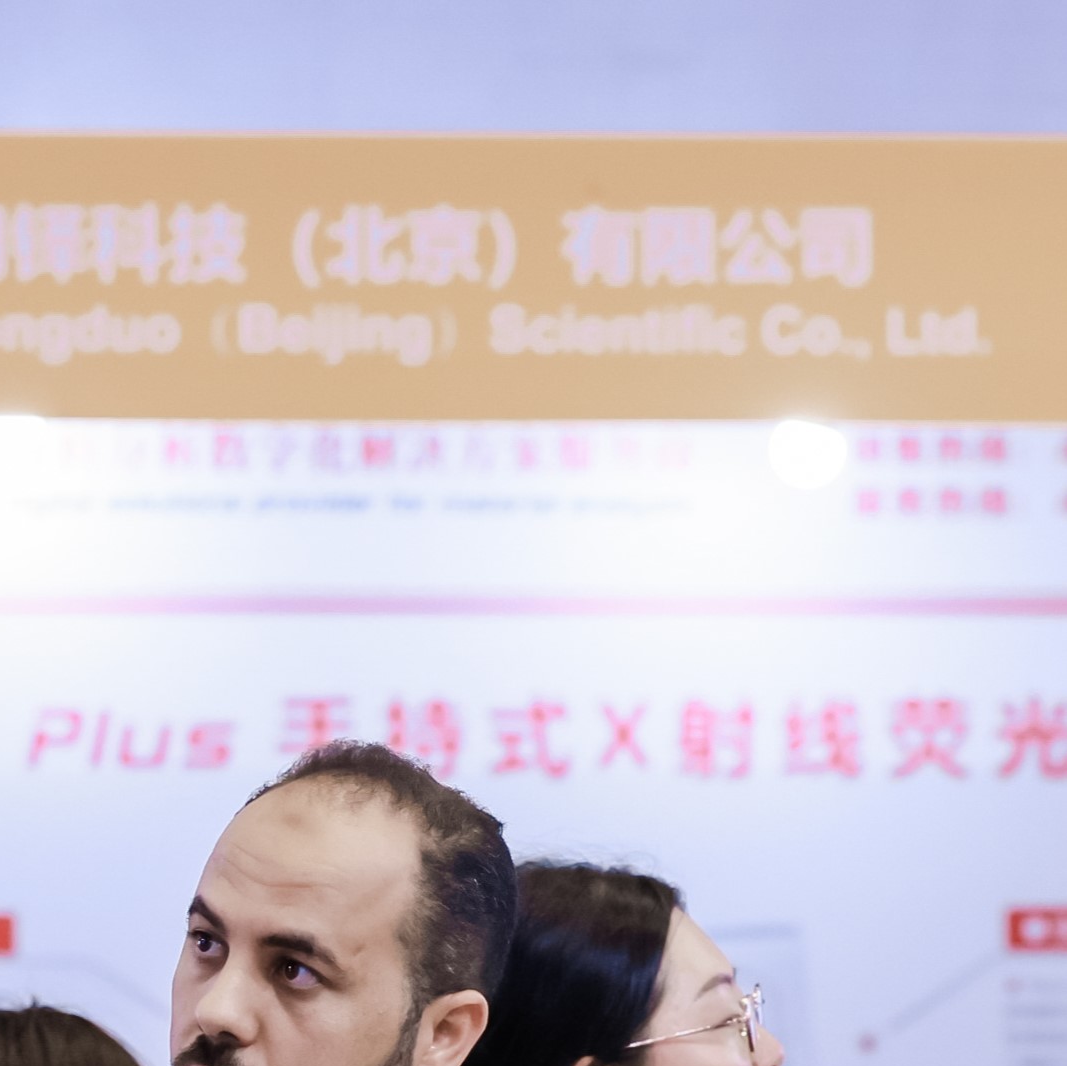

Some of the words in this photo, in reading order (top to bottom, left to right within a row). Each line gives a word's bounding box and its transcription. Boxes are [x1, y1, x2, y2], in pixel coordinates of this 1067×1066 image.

[489, 303, 747, 356] Scientific
[885, 305, 991, 356] Ltd.
[27, 707, 231, 768] Plus
